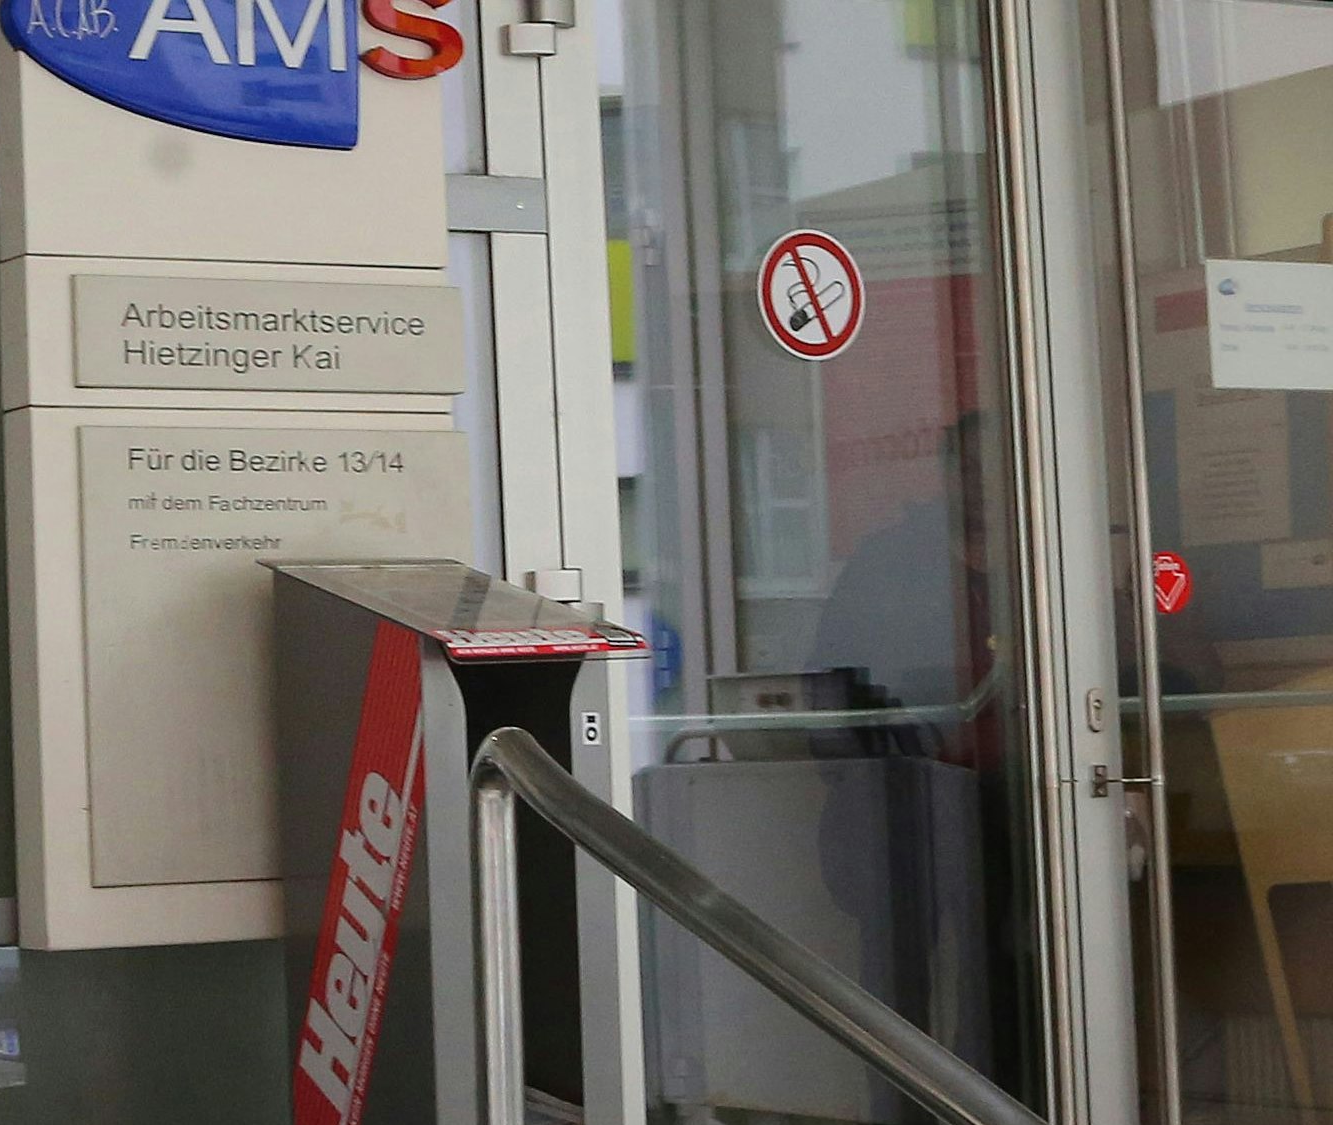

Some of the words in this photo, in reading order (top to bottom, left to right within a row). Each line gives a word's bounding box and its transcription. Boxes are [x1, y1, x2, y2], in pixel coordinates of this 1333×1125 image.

[128, 0, 465, 80] AMS
[120, 302, 425, 337] Arbeitsmarktservice
[123, 340, 283, 375] Hietzinger
[292, 344, 341, 370] Kai
[128, 448, 175, 471] Für
[181, 449, 222, 472] die
[229, 450, 328, 474] Bezirke
[338, 450, 405, 474] 13/14
[128, 491, 158, 511] mit
[161, 494, 203, 511] dem
[208, 494, 329, 513] Fachzentrum
[129, 533, 283, 552] Fremdenverkehr
[299, 771, 403, 1115] Heute
